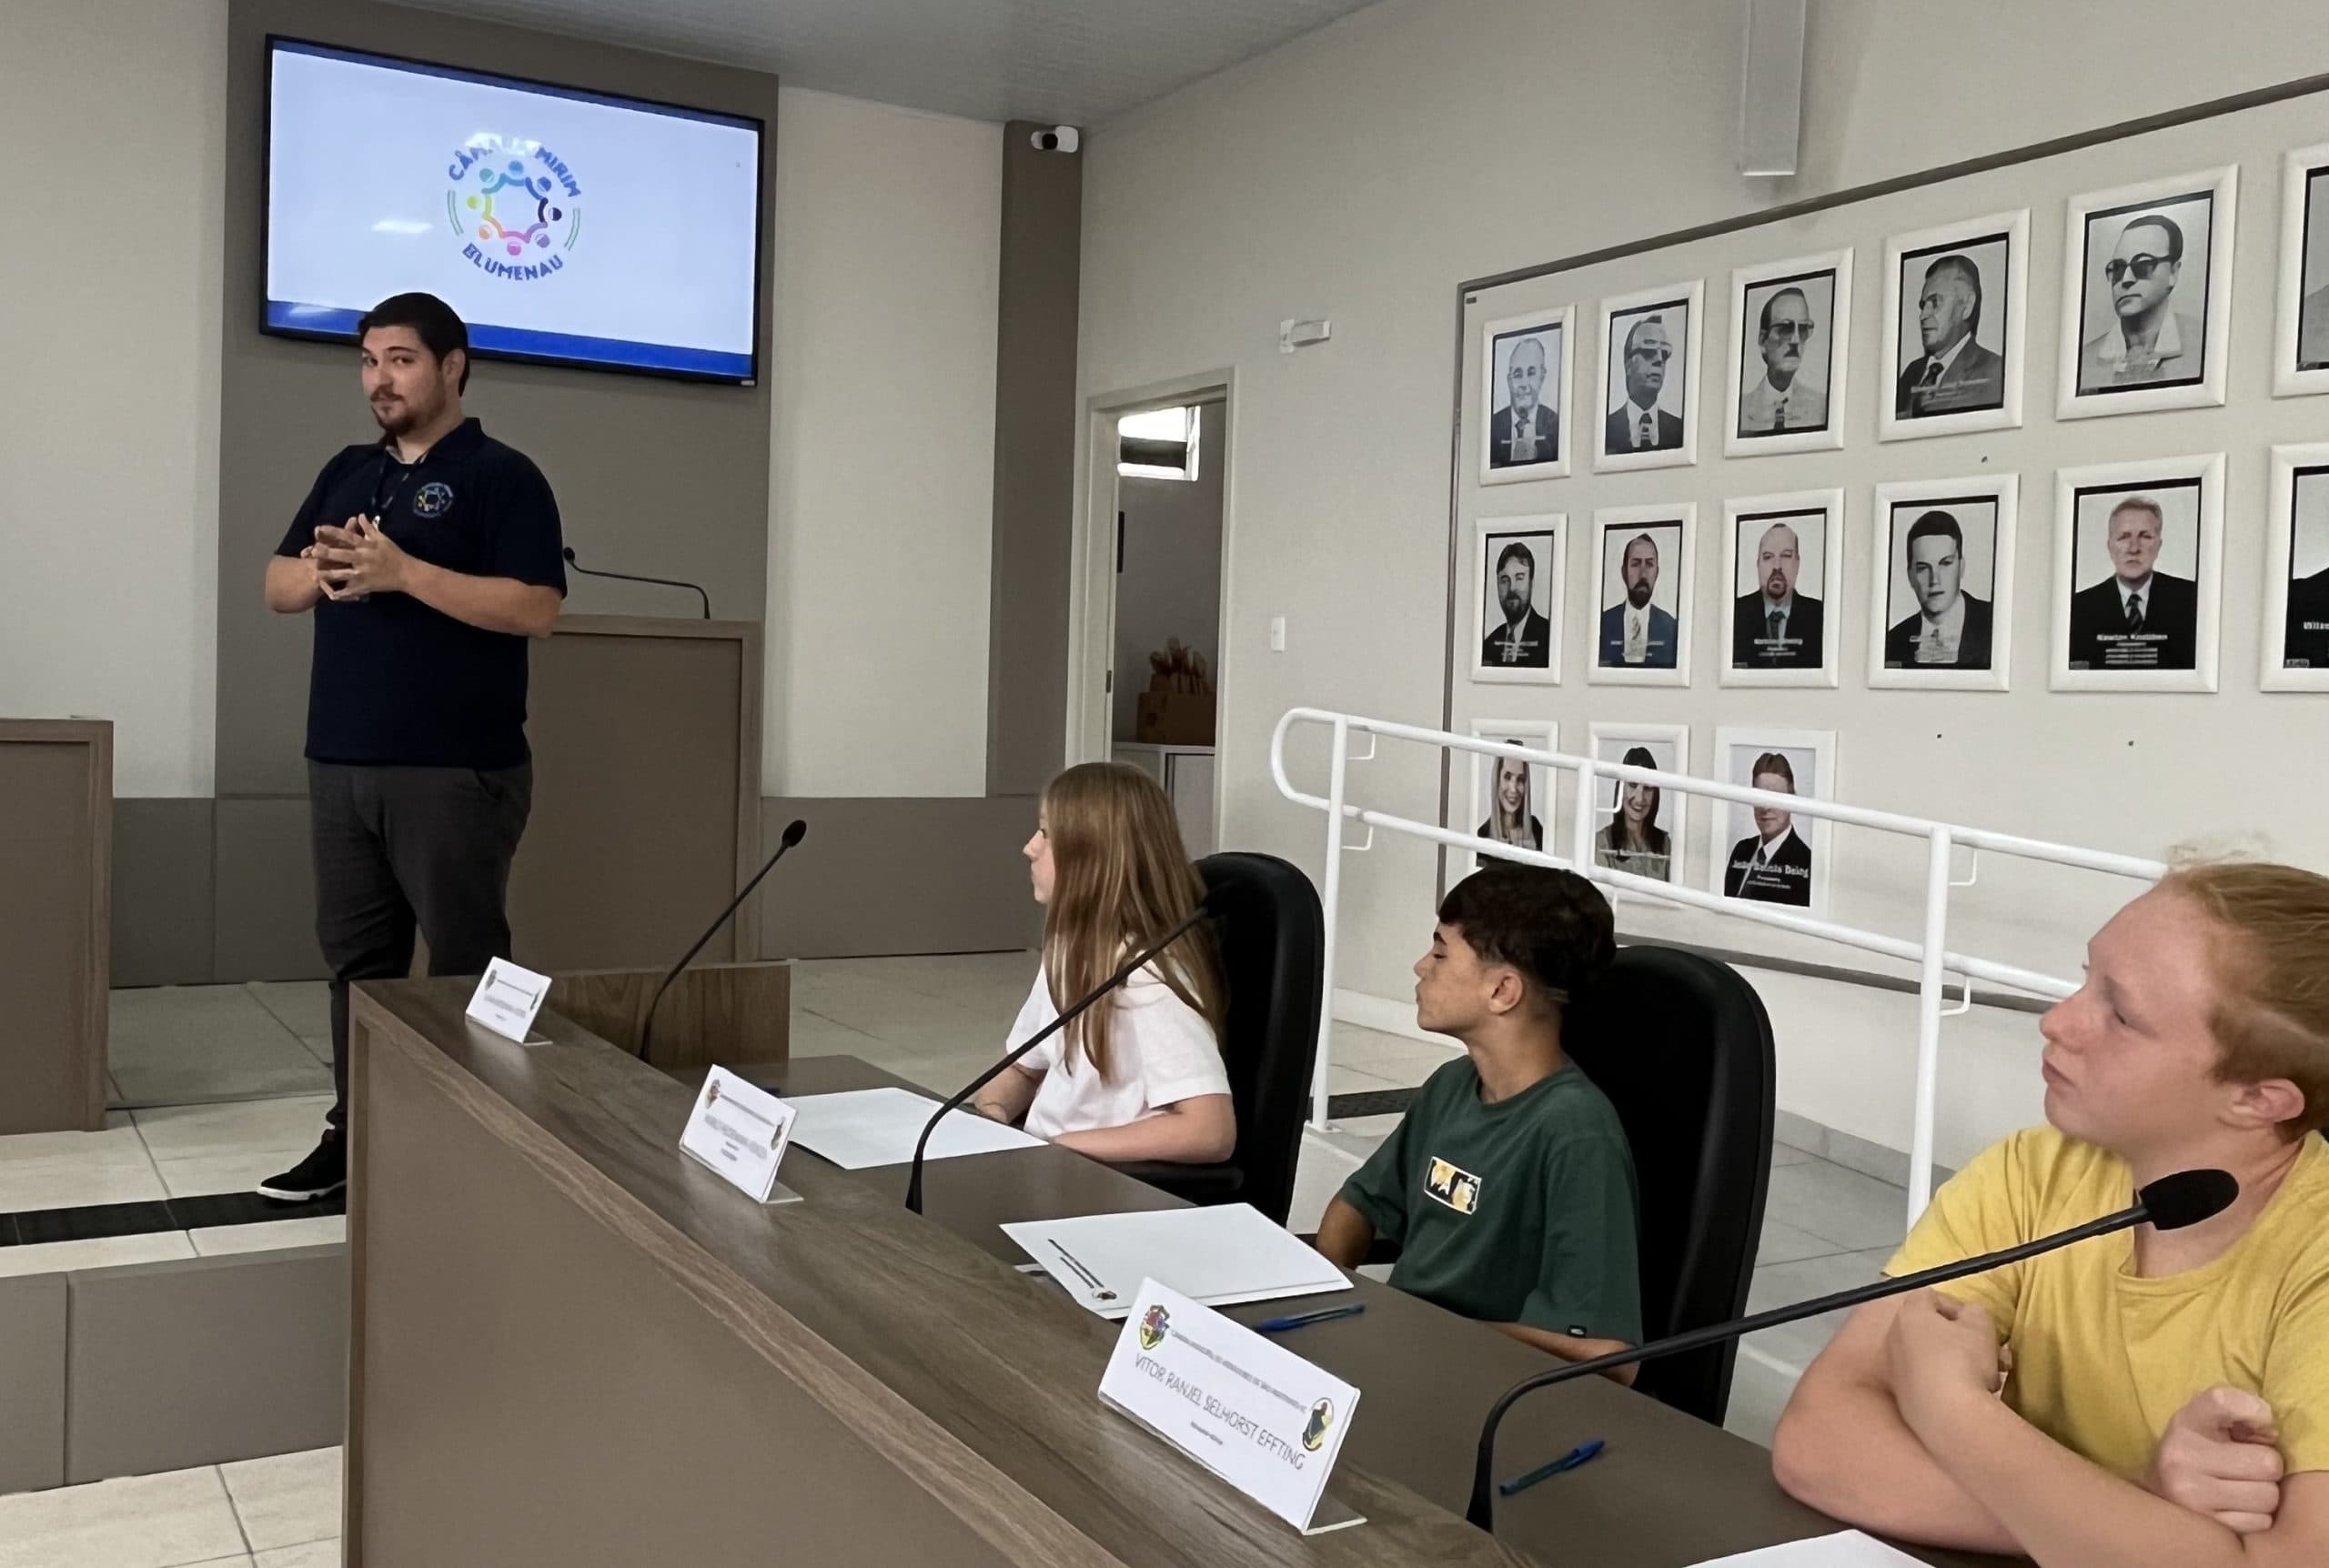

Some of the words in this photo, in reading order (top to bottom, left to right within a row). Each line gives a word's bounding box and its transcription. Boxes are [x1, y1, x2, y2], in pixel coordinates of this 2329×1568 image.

[534, 146, 582, 198] MIRIM
[462, 242, 564, 281] BLUMENAU
[1135, 1352, 1166, 1382] VITOR
[1165, 1371, 1203, 1406] RANJEL
[1203, 1395, 1260, 1438] SELHORST
[1257, 1429, 1306, 1471] EFFTING
